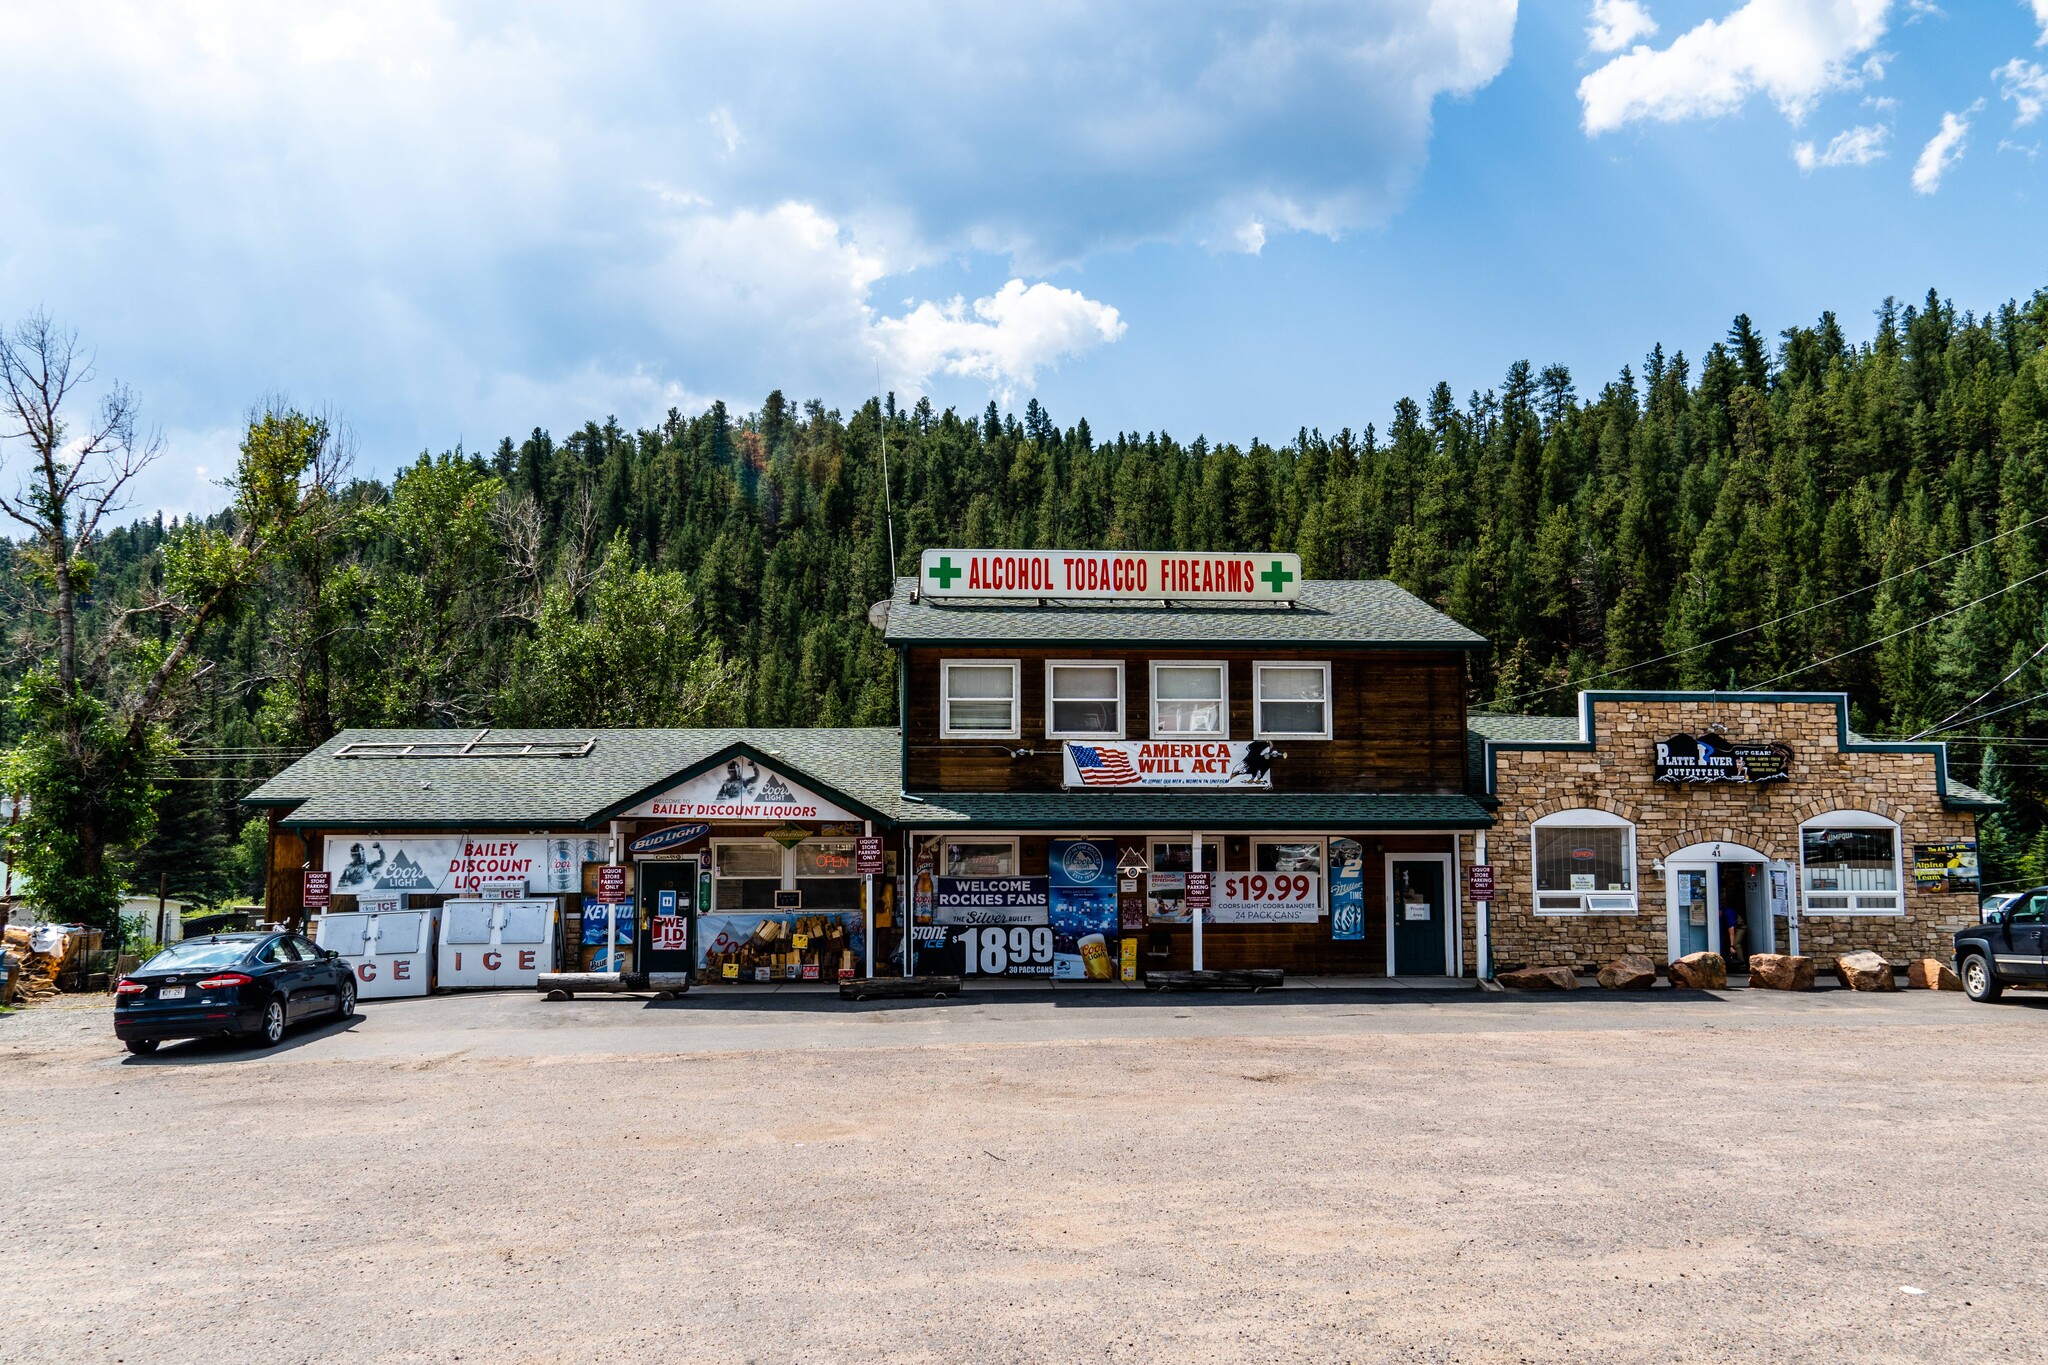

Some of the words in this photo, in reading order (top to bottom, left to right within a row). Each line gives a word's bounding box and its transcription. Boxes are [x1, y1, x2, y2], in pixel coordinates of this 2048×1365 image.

[969, 557, 1053, 590] ALCOHOL
[1064, 558, 1147, 592] TOBACCO
[1161, 559, 1254, 593] FIREARMS
[1138, 744, 1232, 758] AMERICA
[1657, 744, 1695, 766] PLATTE
[1697, 741, 1733, 766] RIVER
[1138, 759, 1184, 773] WILL
[1191, 759, 1230, 773] ACT
[762, 784, 790, 795] Coors
[652, 804, 694, 815] BAILEY
[696, 805, 760, 816] DISCOUNT
[763, 806, 817, 818] LIQUORS
[634, 836, 664, 850] BUD
[666, 826, 703, 840] LIGHT
[464, 844, 518, 856] BAILEY
[450, 860, 532, 872] DISCOUNT
[816, 854, 848, 868] OPEN
[1340, 859, 1362, 877] 2
[382, 862, 426, 879] Coors
[956, 881, 1031, 891] WELCOME
[1226, 875, 1310, 901] $19.99
[1331, 882, 1363, 896] Miller
[501, 890, 521, 899] ICE
[940, 894, 1003, 905] ROCKIES
[1008, 894, 1046, 904] FANS
[377, 902, 397, 911] ICE
[663, 918, 683, 927] WE
[966, 911, 1006, 924] Silver
[665, 929, 685, 941] I.D.
[924, 940, 945, 949] ICE
[455, 950, 536, 971] ICE
[358, 960, 410, 982] CE
[1009, 965, 1017, 973] 30
[1019, 965, 1035, 973] PACK
[1036, 965, 1053, 973] CANS
